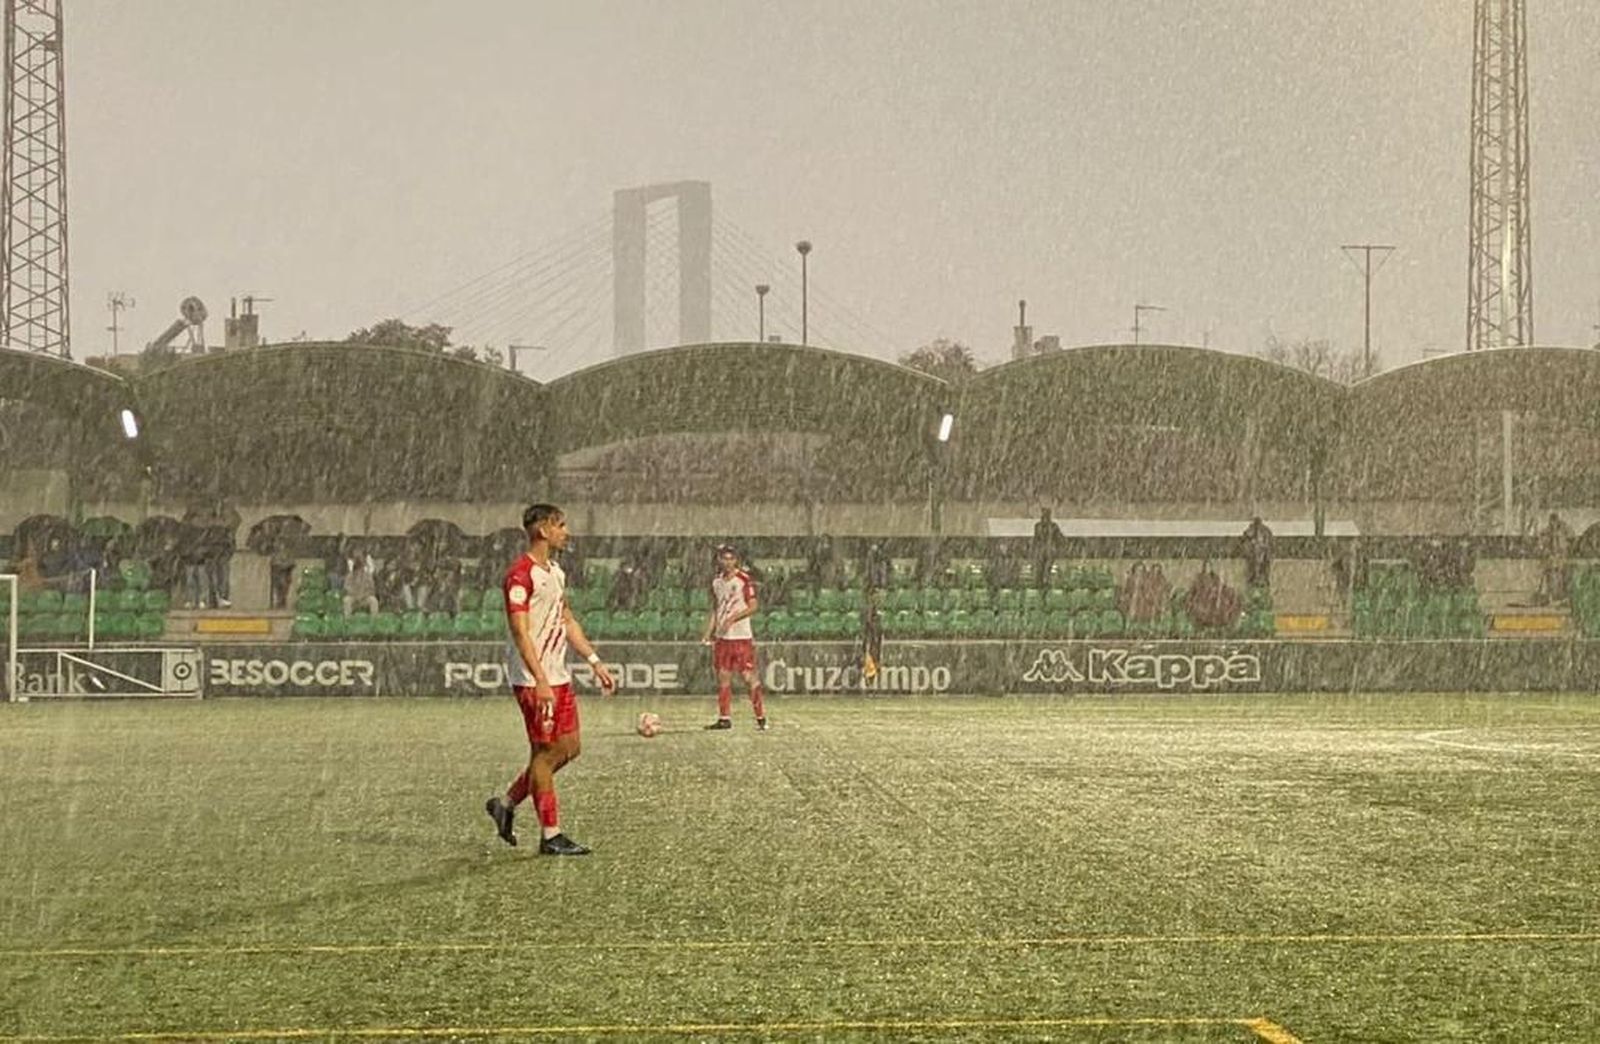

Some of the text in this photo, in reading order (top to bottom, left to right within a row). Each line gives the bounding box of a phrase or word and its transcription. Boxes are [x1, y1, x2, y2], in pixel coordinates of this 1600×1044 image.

[210, 659, 374, 687] BESOCCER
[444, 662, 679, 689] PORADE
[1089, 649, 1261, 688] Kappa
